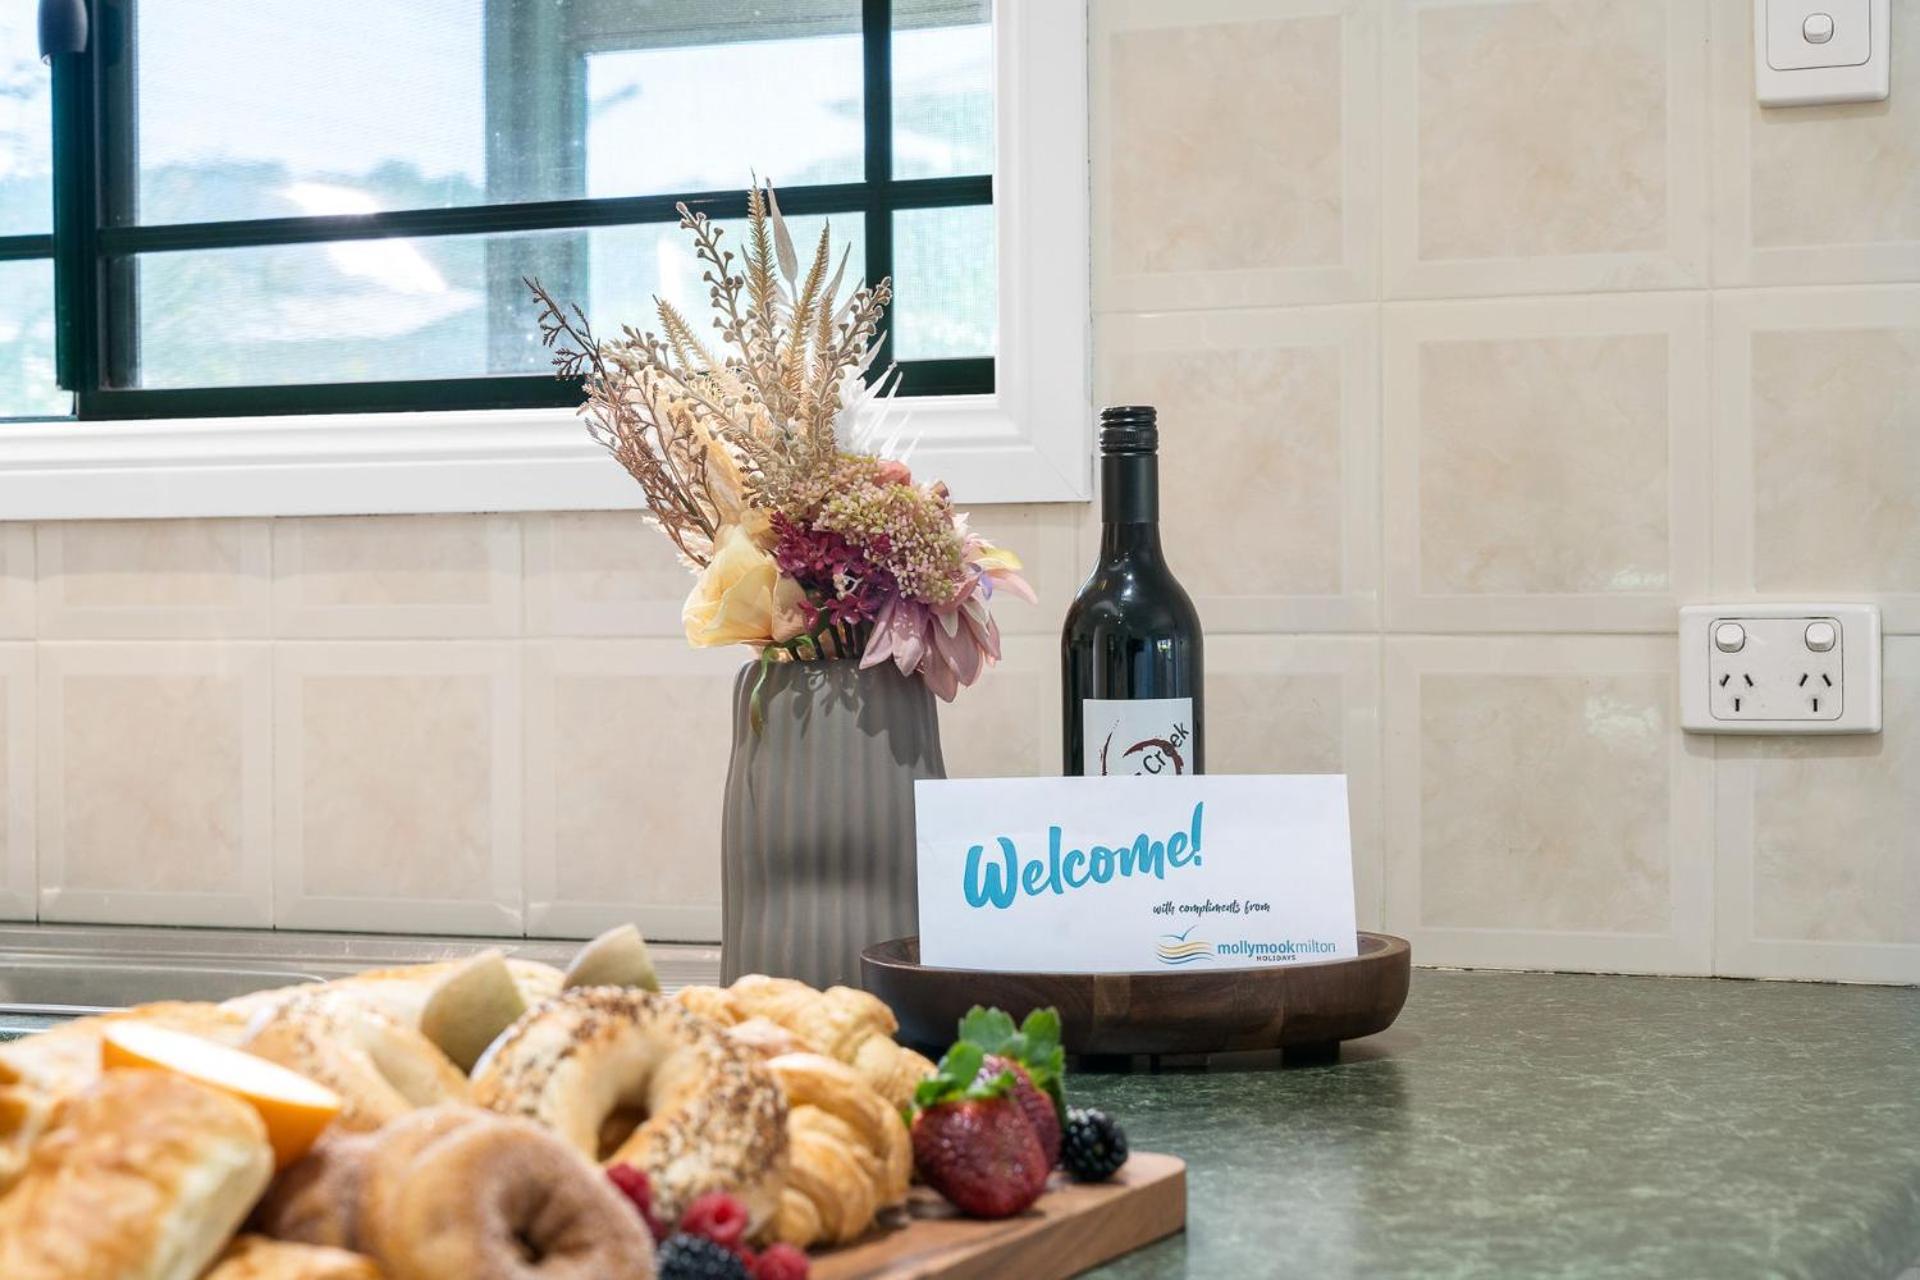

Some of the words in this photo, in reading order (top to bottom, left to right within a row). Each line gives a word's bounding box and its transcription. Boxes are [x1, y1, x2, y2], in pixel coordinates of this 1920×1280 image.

[963, 800, 1204, 909] Welcome!
[1153, 901, 1175, 915] with
[1178, 899, 1241, 917] compliments
[1244, 900, 1271, 915] from
[1217, 939, 1336, 958] mollymookmilton
[1256, 954, 1296, 962] HOLIDAYS
